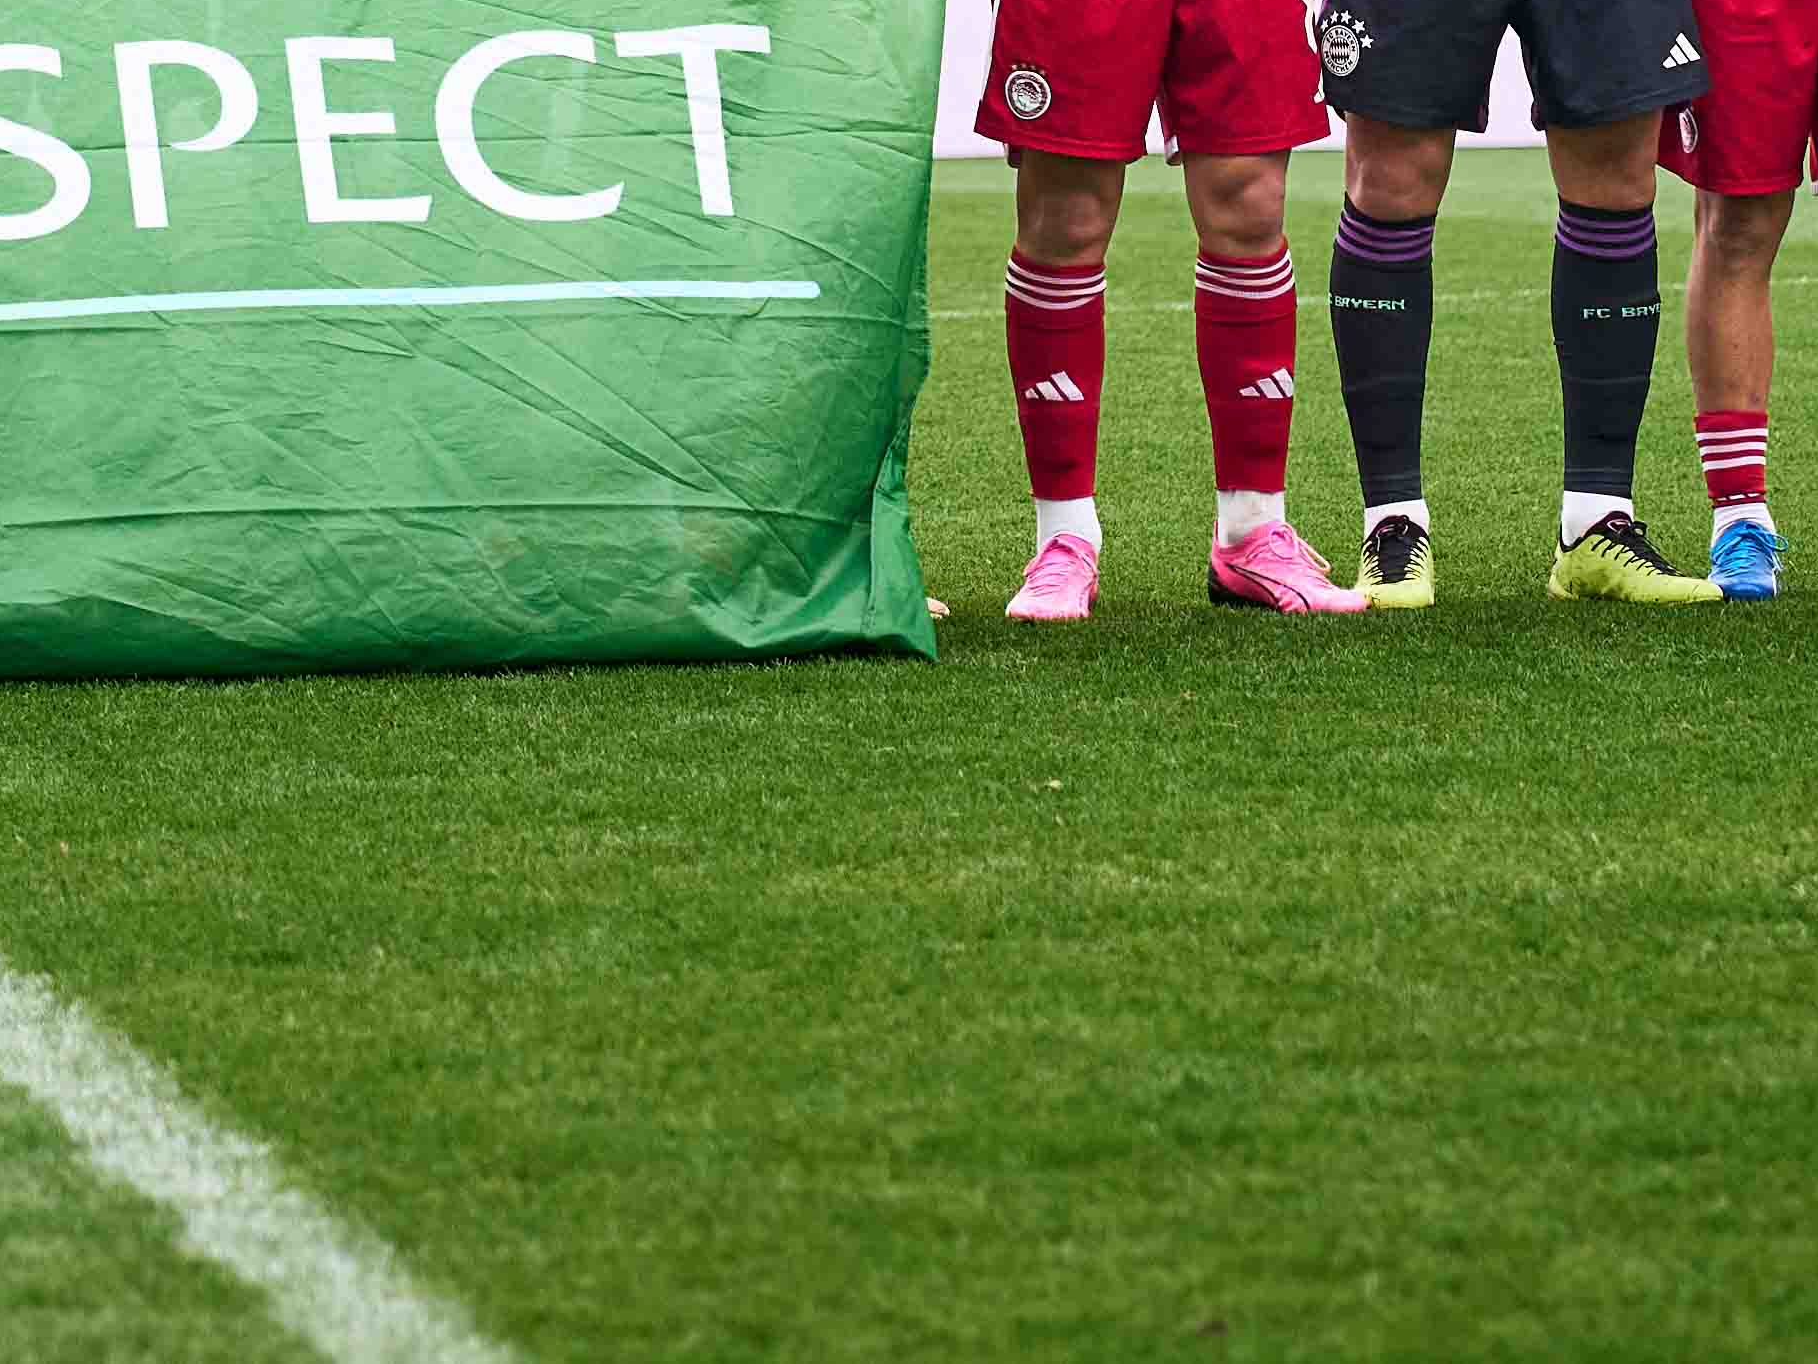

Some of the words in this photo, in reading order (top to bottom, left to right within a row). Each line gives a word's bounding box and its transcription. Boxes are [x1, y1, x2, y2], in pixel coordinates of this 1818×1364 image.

[1334, 295, 1405, 310] BAYERN
[1583, 308, 1611, 319] FC
[1621, 303, 1661, 317] BAYE
